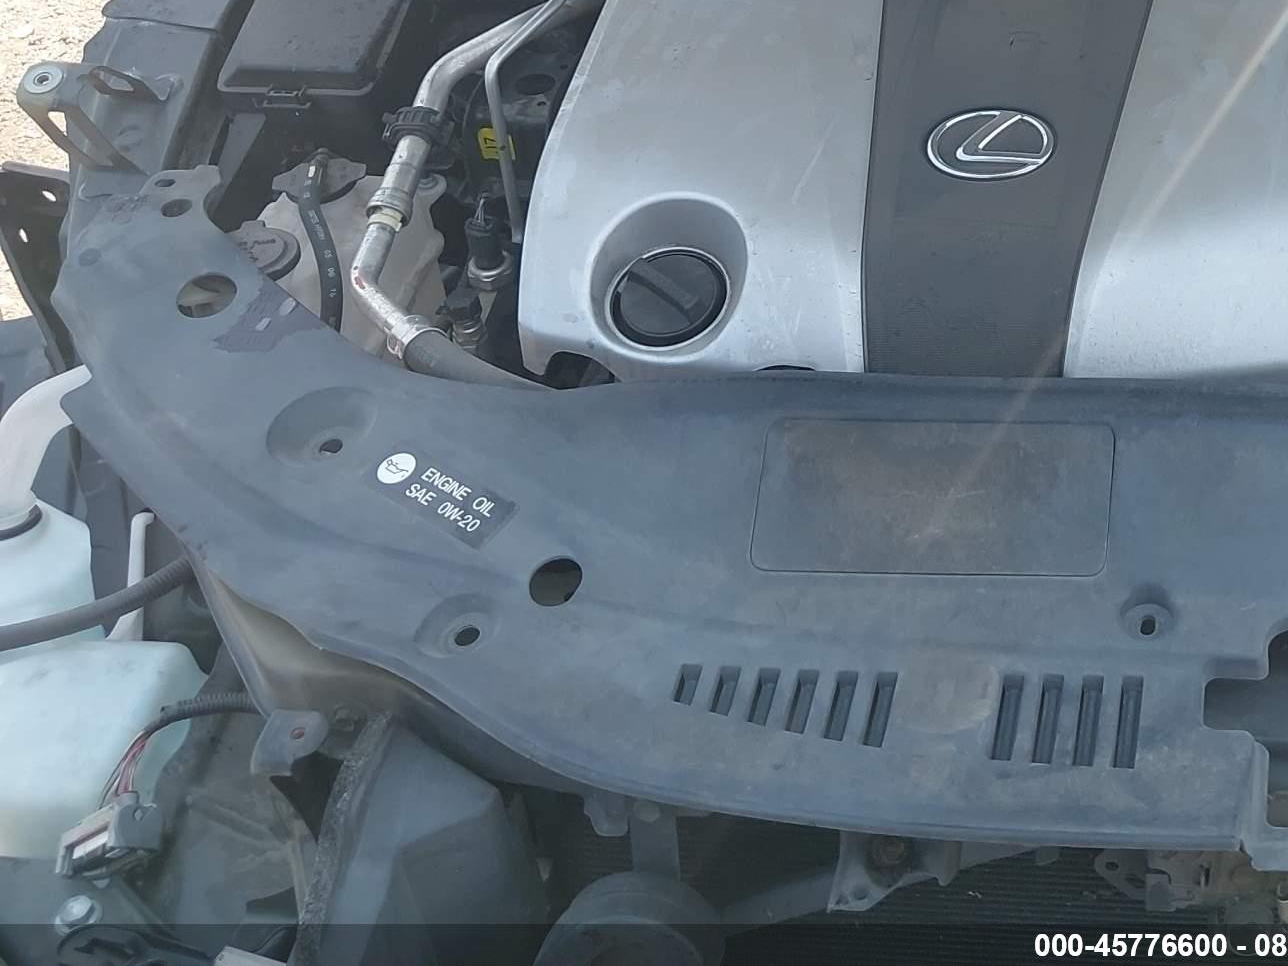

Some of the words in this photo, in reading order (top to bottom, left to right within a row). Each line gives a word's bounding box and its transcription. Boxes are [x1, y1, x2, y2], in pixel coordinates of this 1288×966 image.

[405, 483, 437, 506] SAE
[437, 501, 481, 532] 0W-20
[421, 467, 472, 501] ENGINE
[472, 496, 495, 518] OIL
